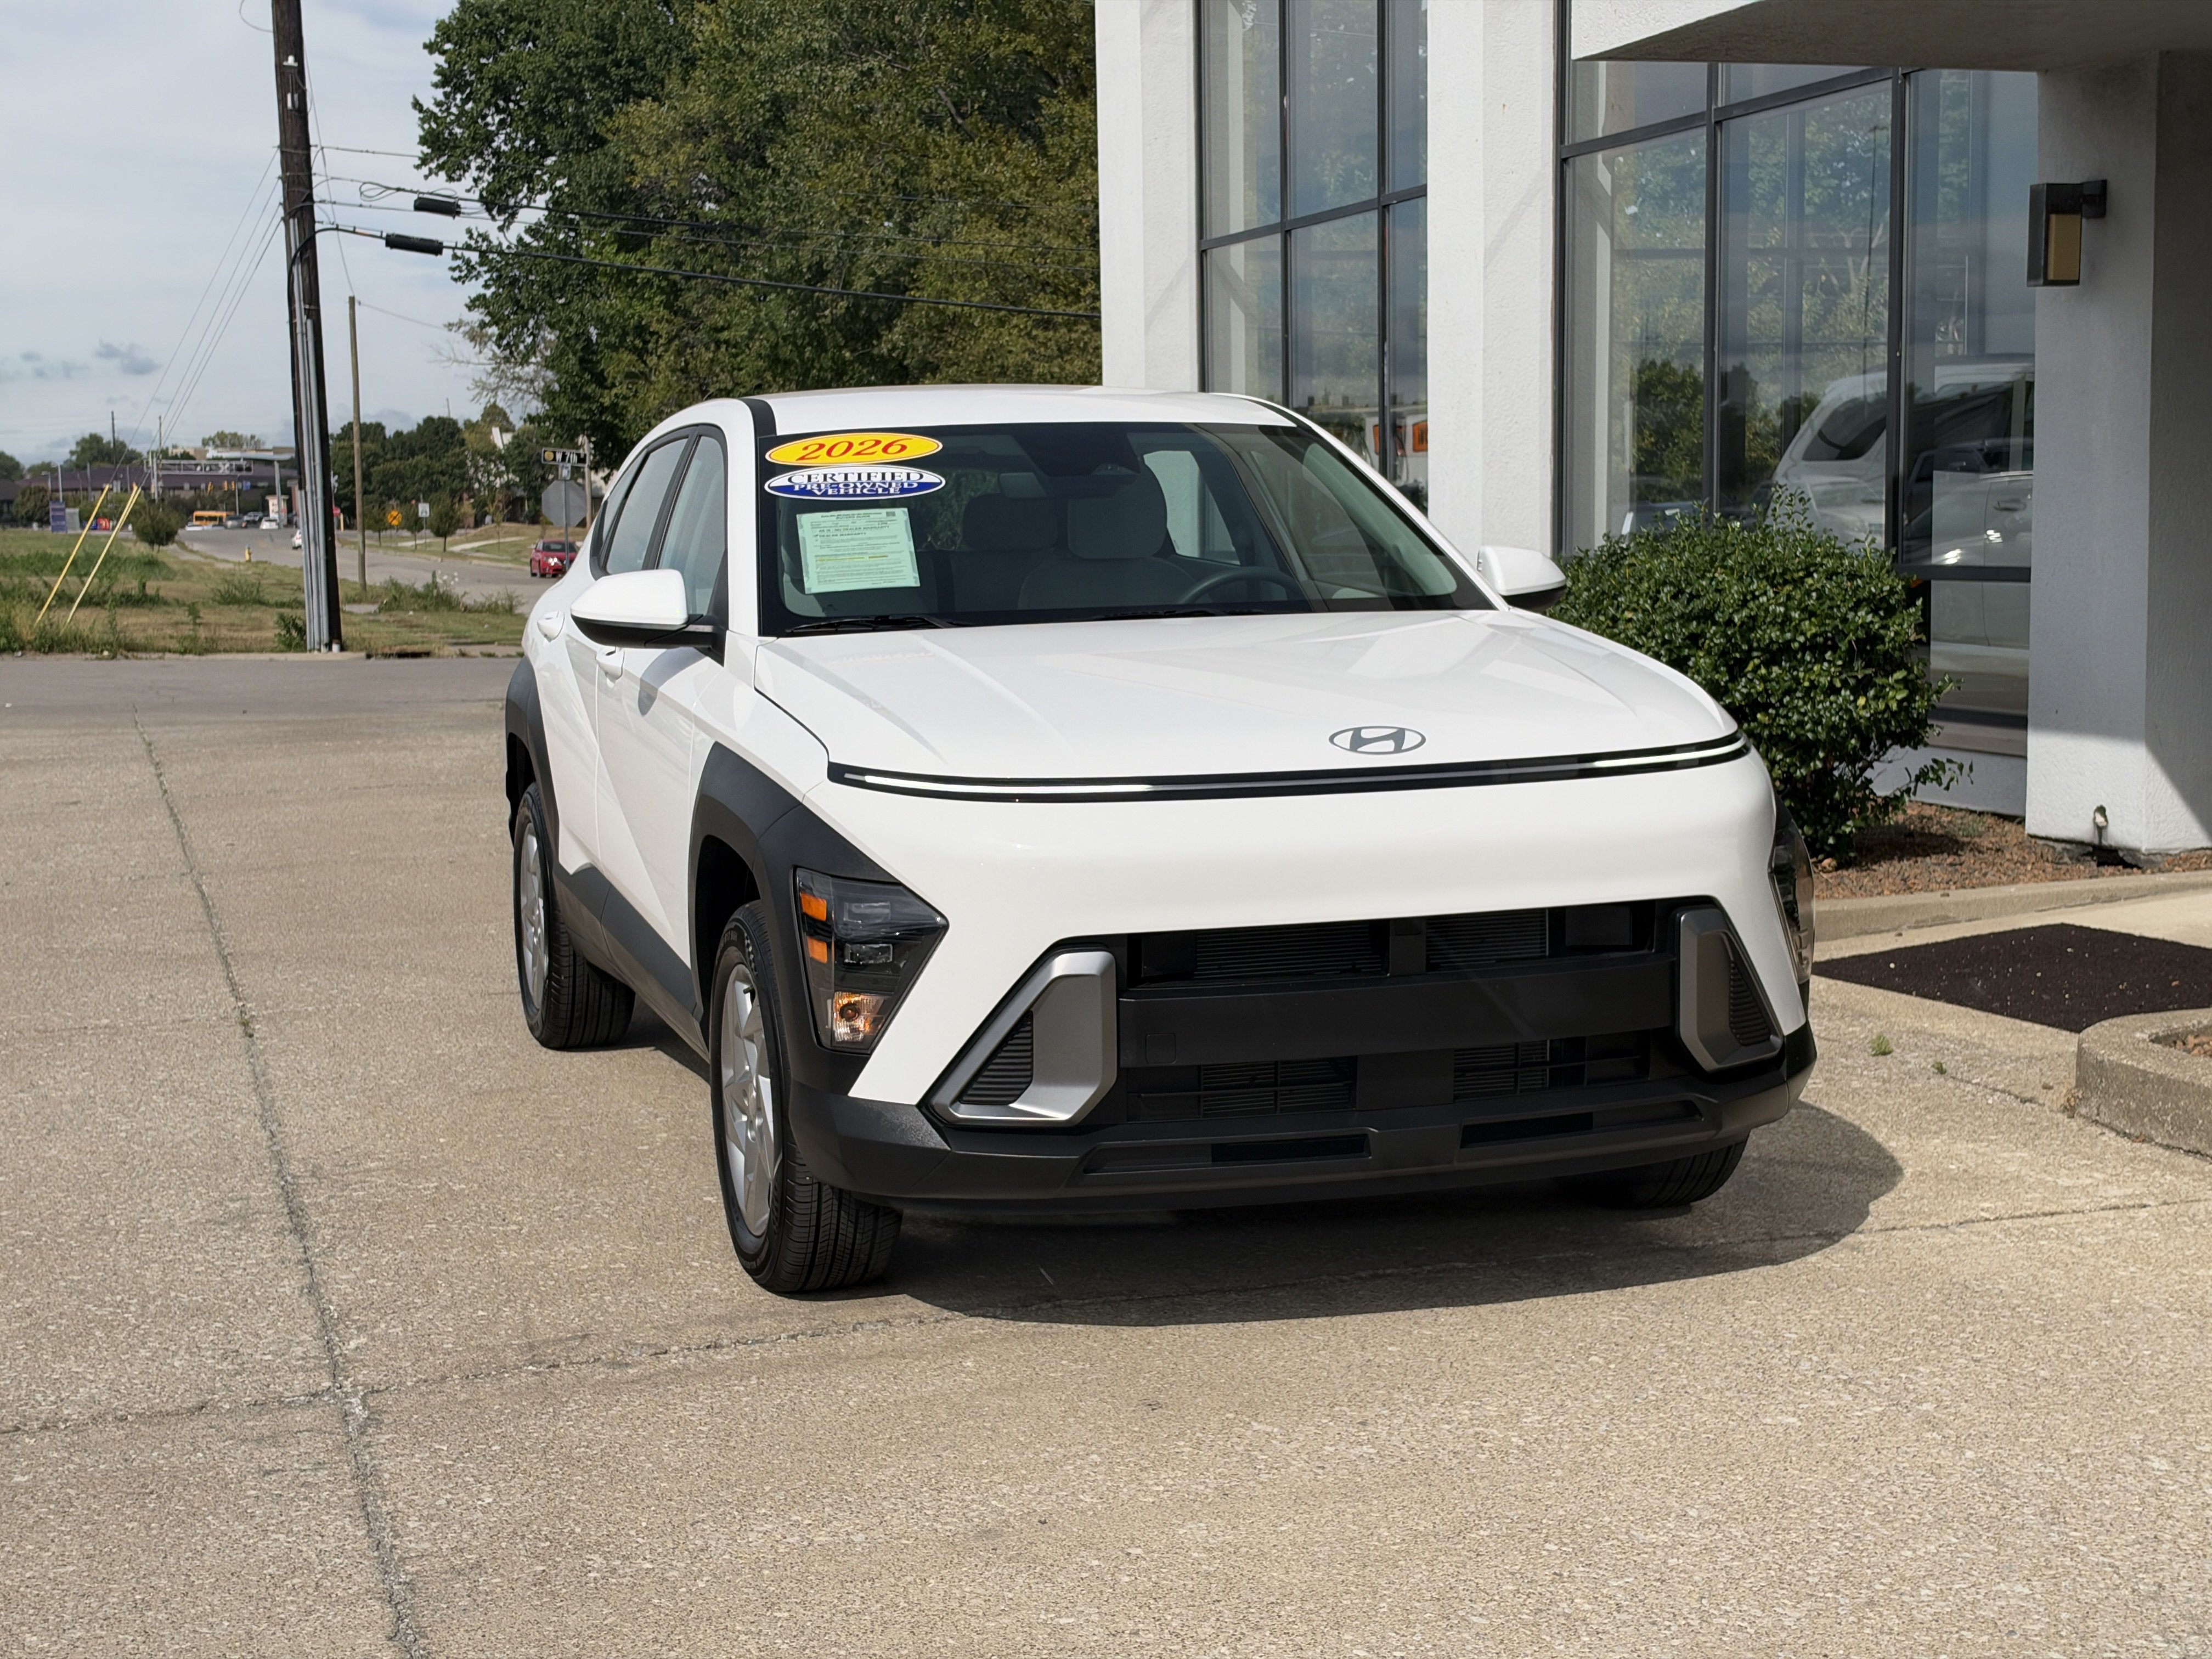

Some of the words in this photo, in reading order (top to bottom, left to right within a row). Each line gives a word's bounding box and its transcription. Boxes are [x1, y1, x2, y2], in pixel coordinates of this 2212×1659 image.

[795, 438, 913, 462] 2026
[555, 451, 563, 463] W
[787, 472, 924, 484] CERTIFIED
[793, 482, 918, 491] PRE-OWNED
[811, 487, 900, 495] VEHICLE
